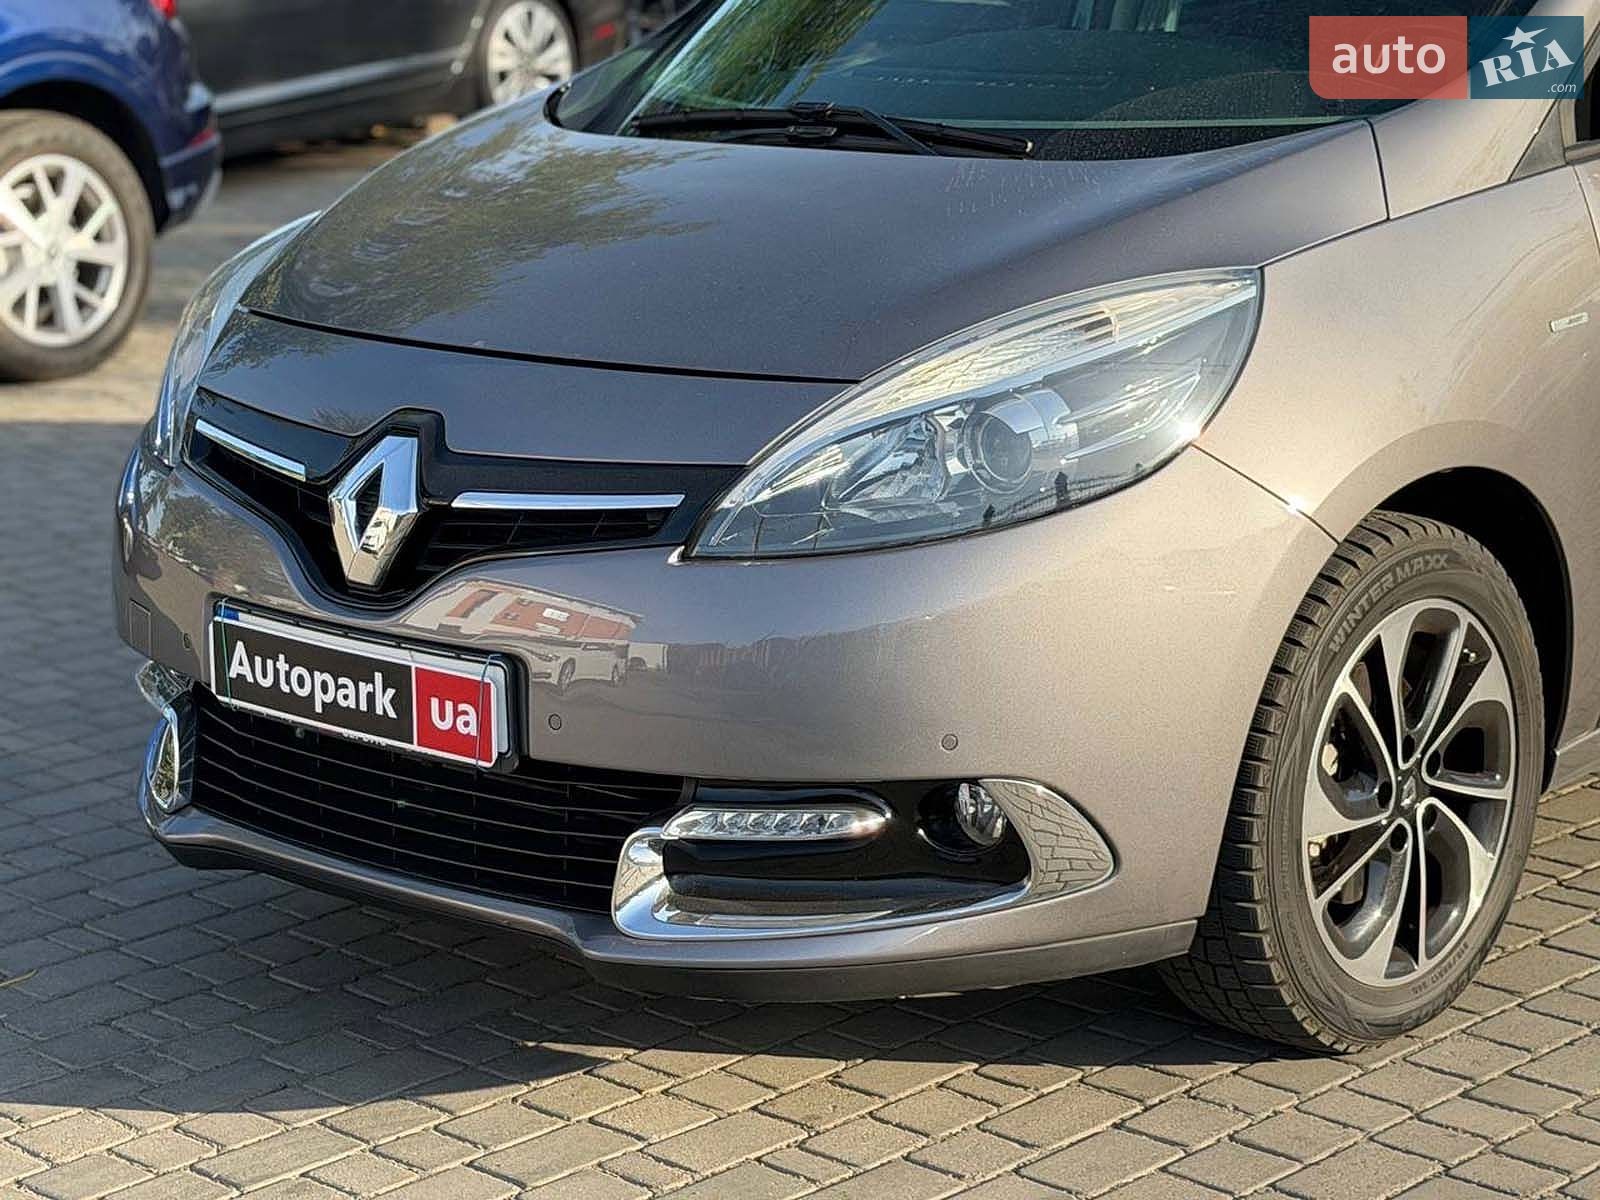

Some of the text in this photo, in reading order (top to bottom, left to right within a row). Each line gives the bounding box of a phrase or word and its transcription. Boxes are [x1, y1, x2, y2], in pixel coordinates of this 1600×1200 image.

[1328, 553, 1449, 652] WINTER MAXX
[229, 640, 478, 737] Autopark ua
